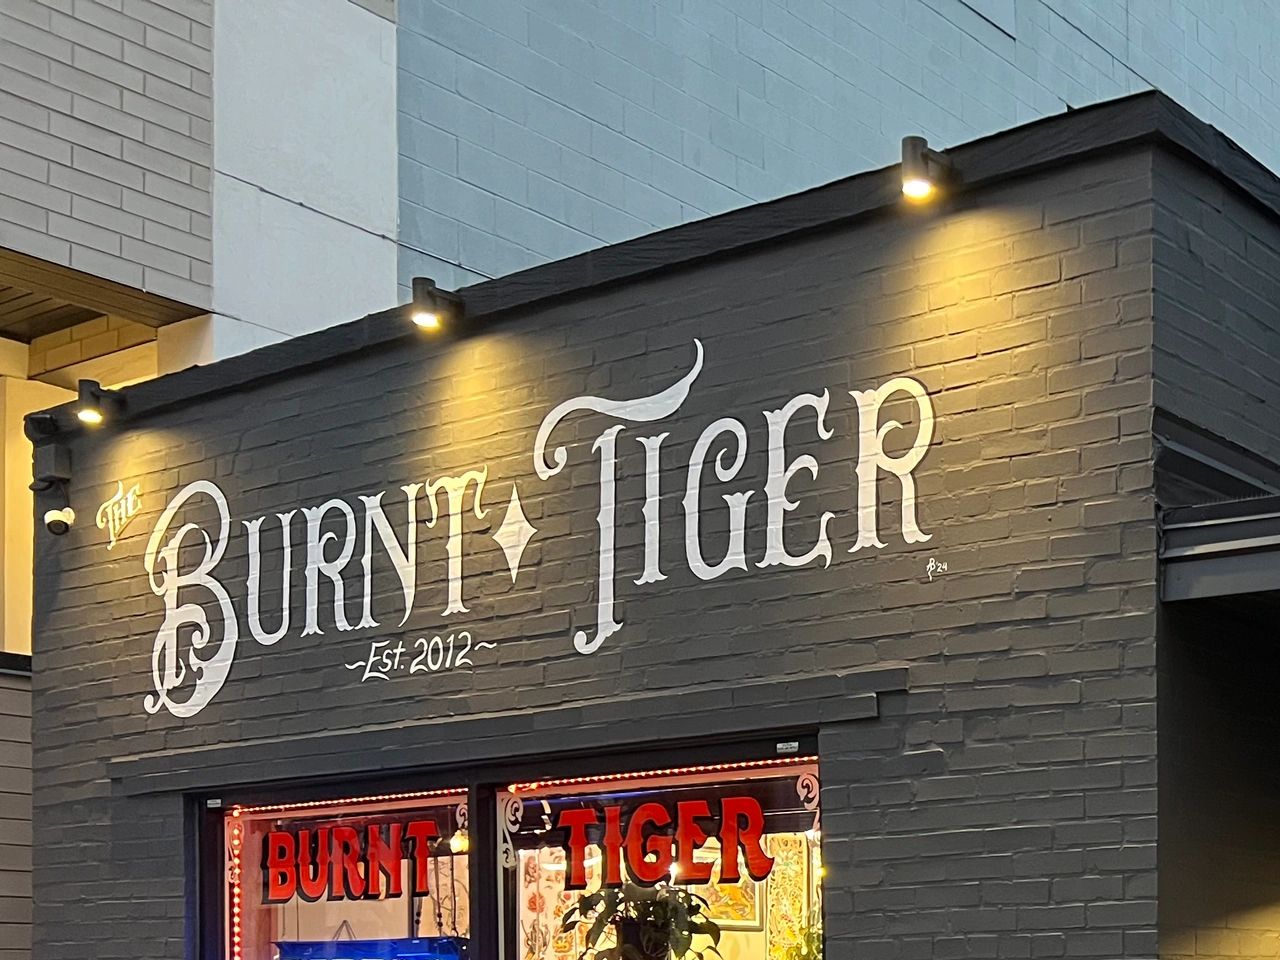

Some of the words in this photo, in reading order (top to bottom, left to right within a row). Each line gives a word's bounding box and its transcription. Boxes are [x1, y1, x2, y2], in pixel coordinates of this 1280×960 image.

[96, 480, 142, 550] THE
[144, 464, 488, 718] BURNT
[534, 338, 932, 655] TIGER
[410, 631, 474, 674] 2012
[263, 821, 440, 903] BURNT
[557, 796, 775, 890] TIGER
